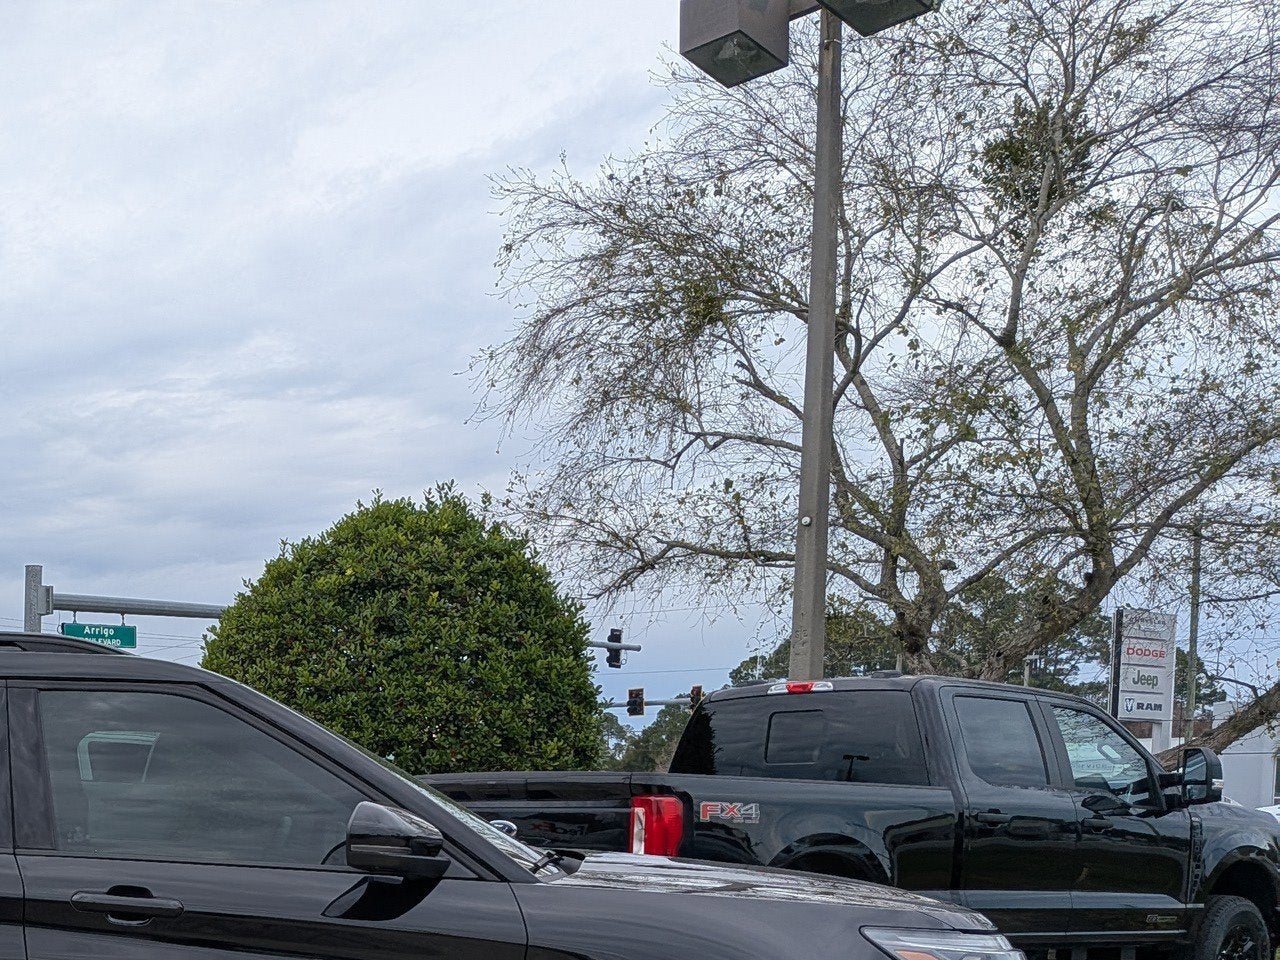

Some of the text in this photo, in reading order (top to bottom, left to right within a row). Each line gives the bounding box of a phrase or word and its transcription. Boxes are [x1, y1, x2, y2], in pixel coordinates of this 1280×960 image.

[83, 625, 115, 637] Arrigo
[81, 637, 122, 646] LEVARD
[1126, 647, 1165, 659] DODGE
[1132, 670, 1159, 689] Jeep
[1136, 701, 1163, 712] RAM
[699, 801, 760, 822] FX4
